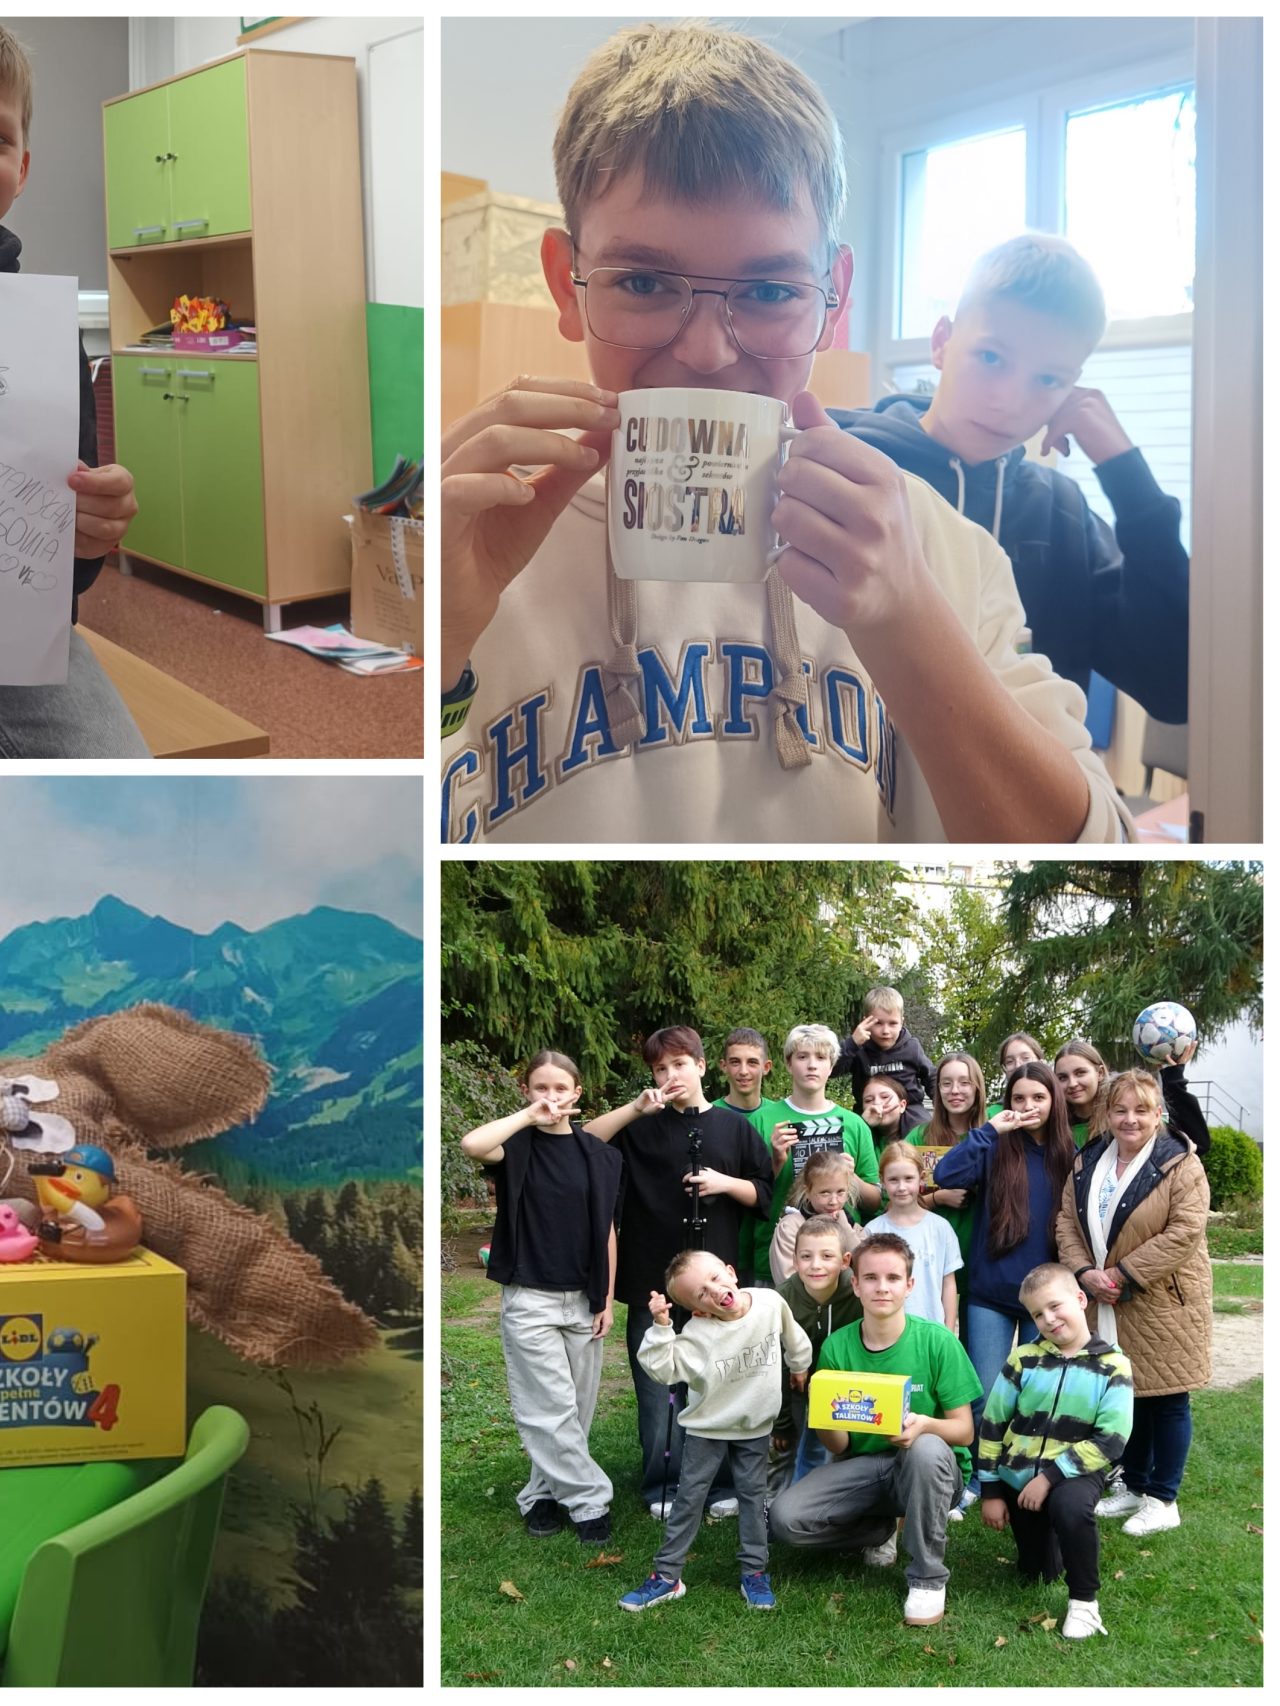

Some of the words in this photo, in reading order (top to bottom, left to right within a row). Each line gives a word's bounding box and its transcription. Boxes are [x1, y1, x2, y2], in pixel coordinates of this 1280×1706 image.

[626, 416, 749, 459] CUDOWNA
[622, 478, 746, 536] SIOSTRA
[0, 1386, 41, 1401] pełne
[87, 1383, 121, 1431] 4
[841, 1403, 869, 1412] SZKOŁY
[835, 1412, 874, 1422] TALENTÓW
